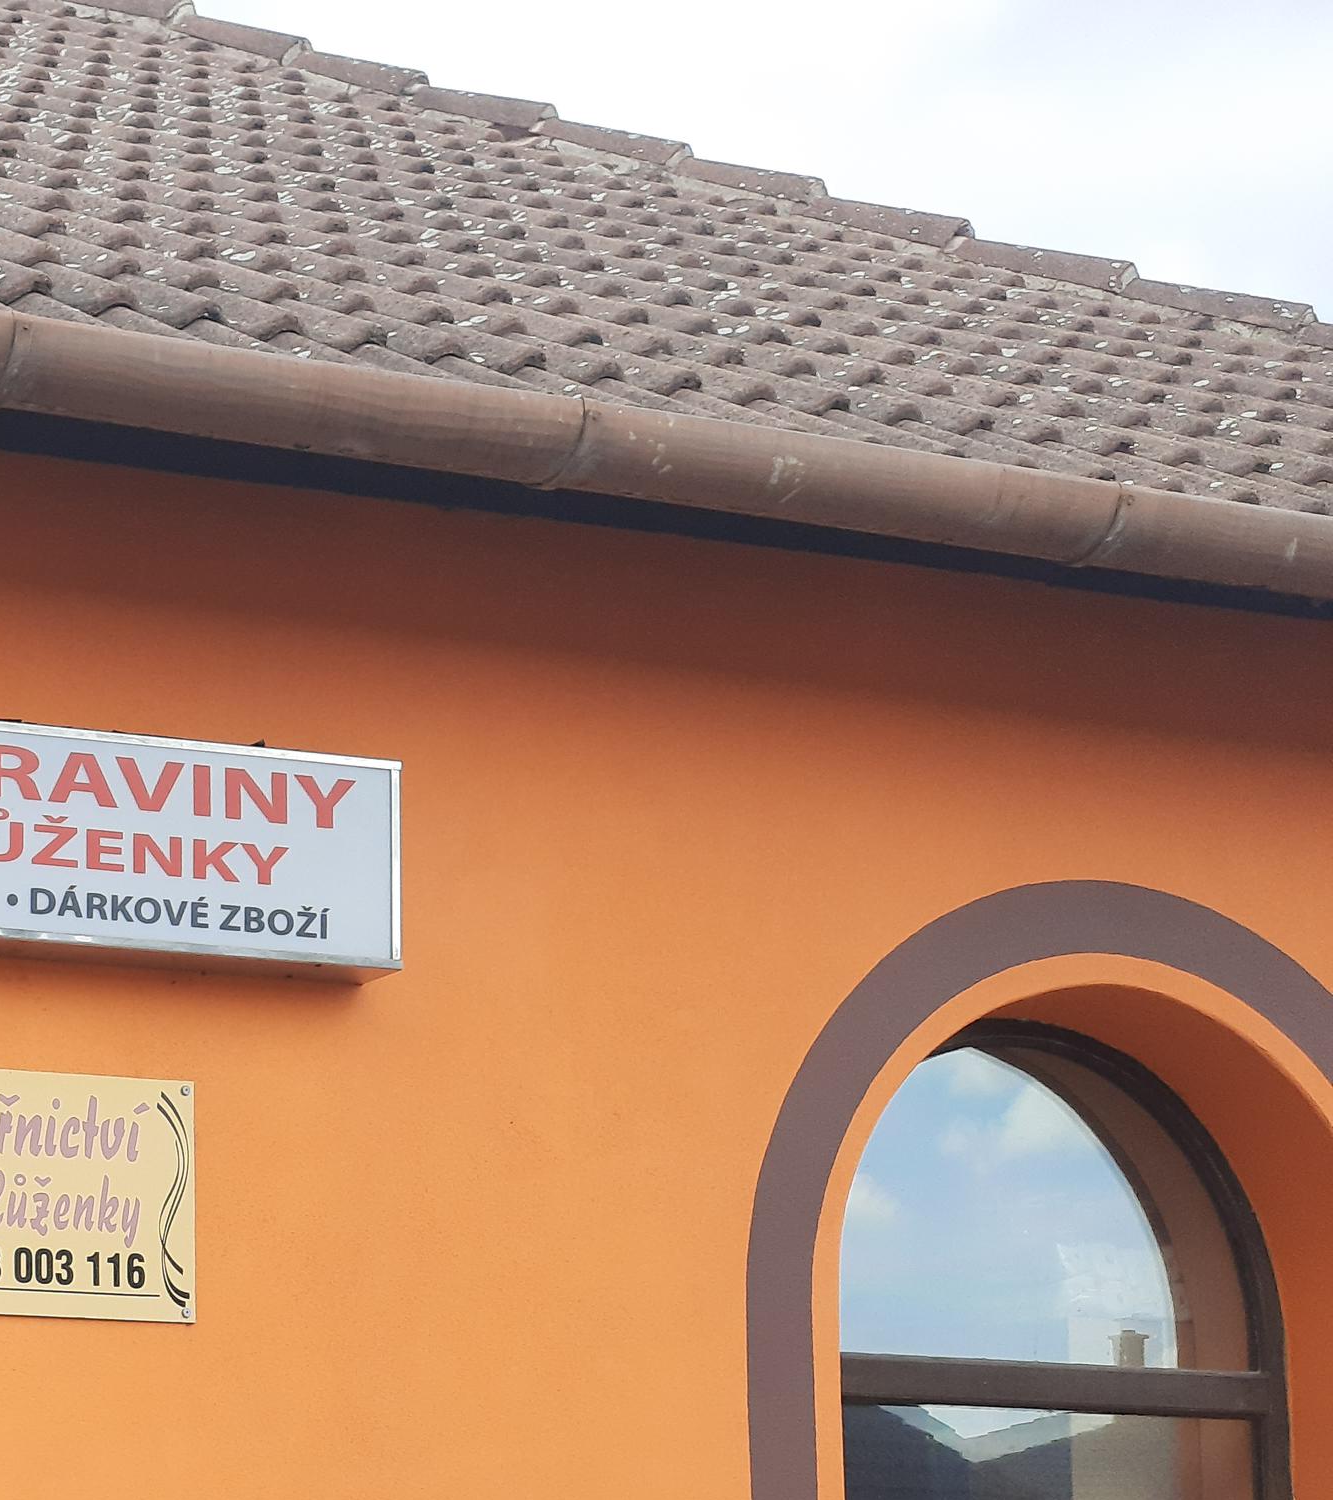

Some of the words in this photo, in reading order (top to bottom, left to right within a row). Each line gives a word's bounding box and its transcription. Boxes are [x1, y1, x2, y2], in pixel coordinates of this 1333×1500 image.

[29, 883, 210, 929] DÁRKOVÉ
[218, 903, 330, 940] ZBOŽÍ
[13, 1247, 74, 1287] 003
[86, 1251, 146, 1289] 116
